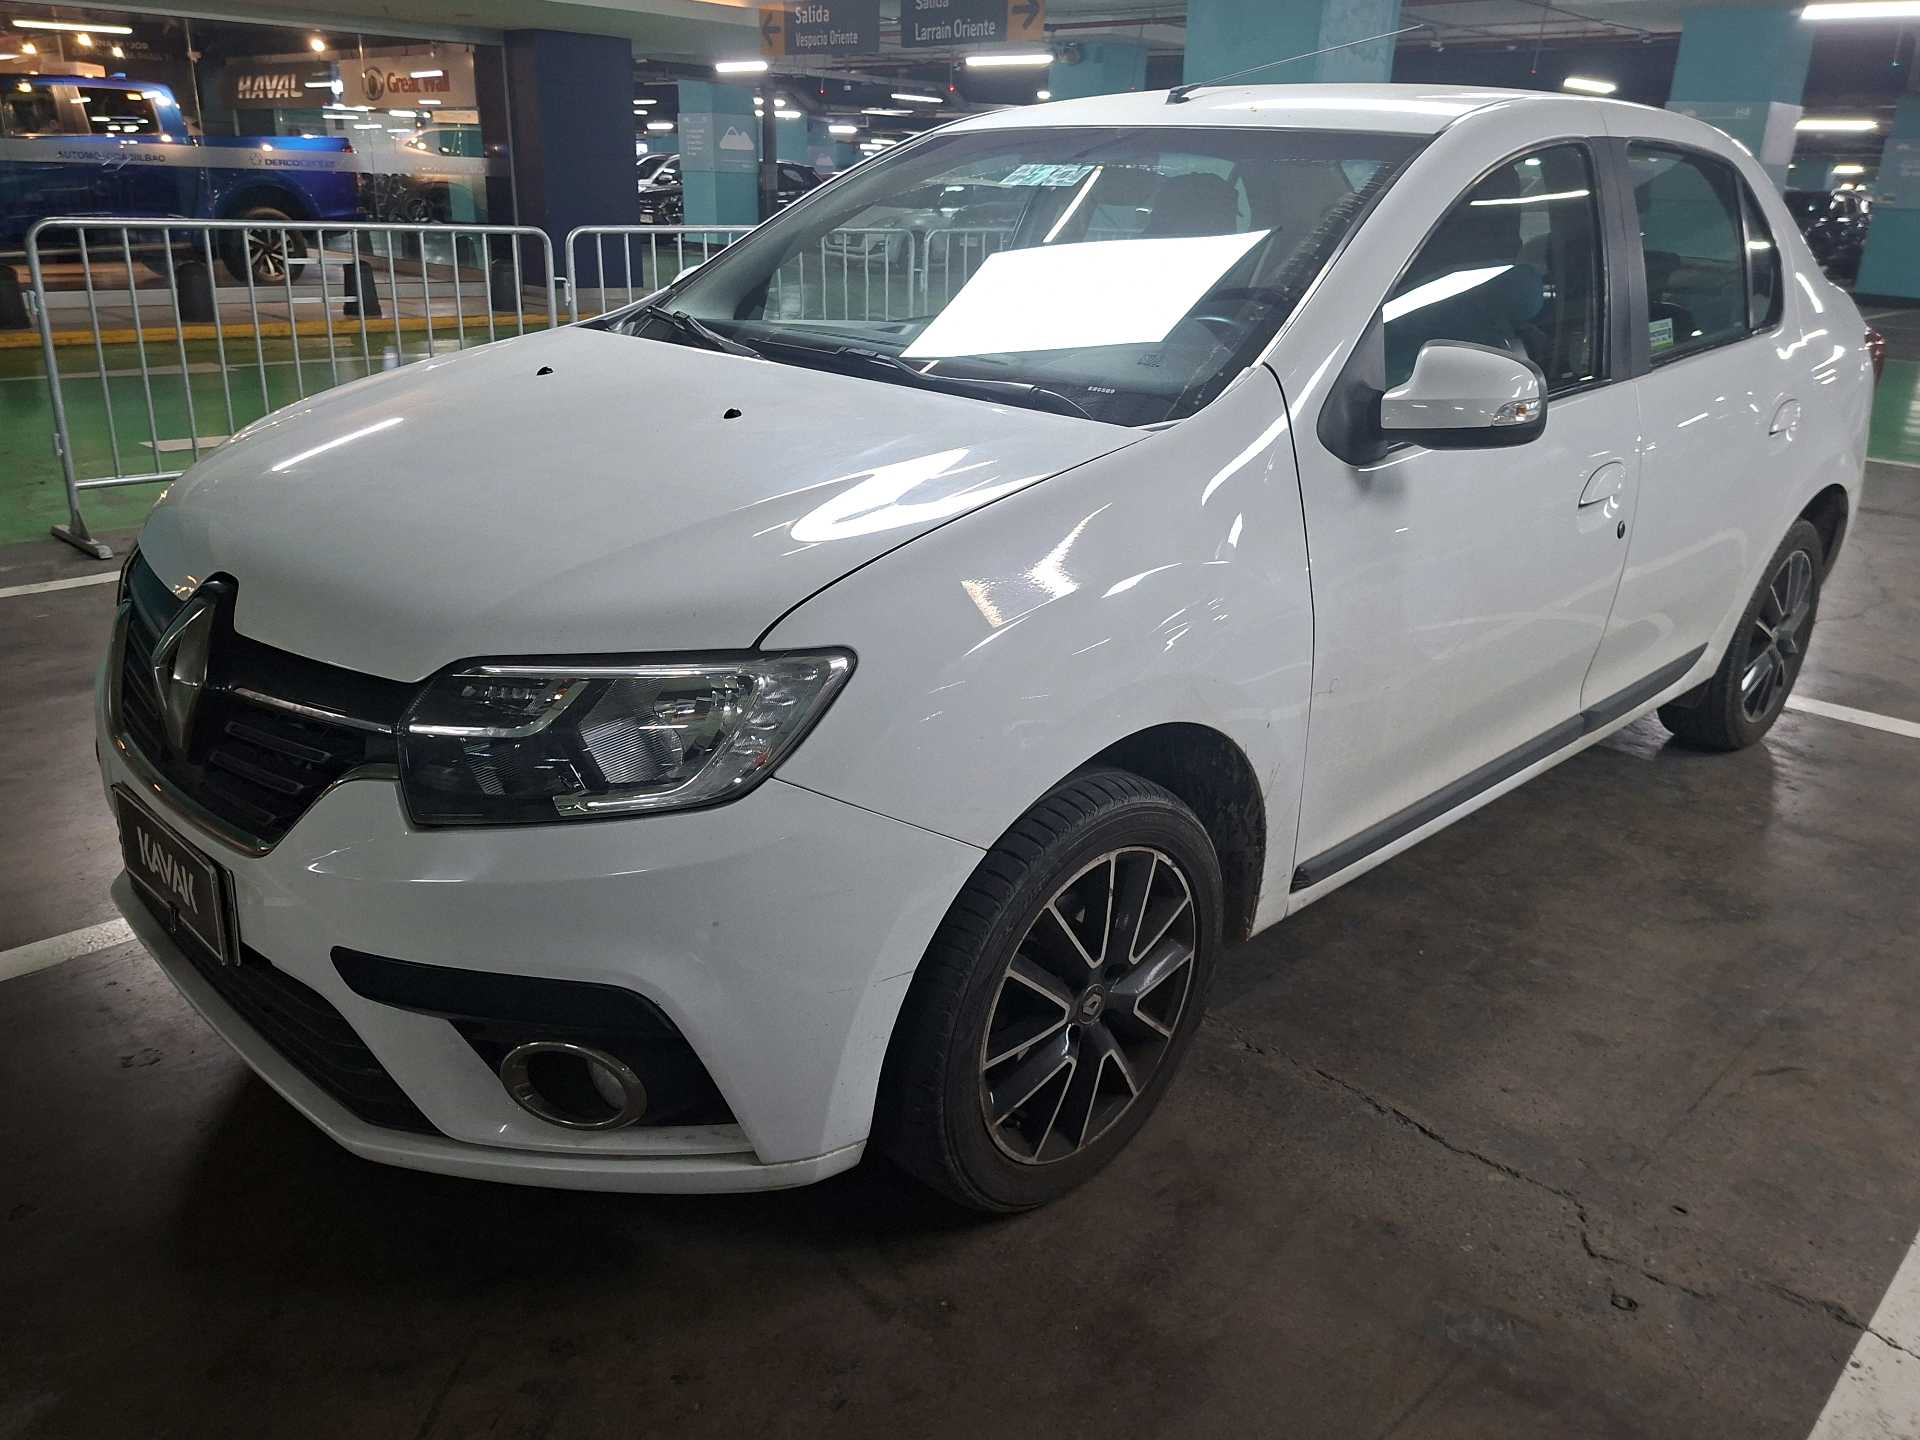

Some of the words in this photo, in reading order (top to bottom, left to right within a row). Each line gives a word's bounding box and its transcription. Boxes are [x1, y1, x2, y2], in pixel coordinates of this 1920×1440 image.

[795, 5, 830, 24] Salida
[953, 18, 996, 38] Oriente
[795, 31, 828, 49] Vespucio
[829, 29, 859, 46] Oriente
[238, 74, 303, 99] HAVAL
[387, 72, 420, 93] Great
[136, 825, 199, 915] KAVAK
